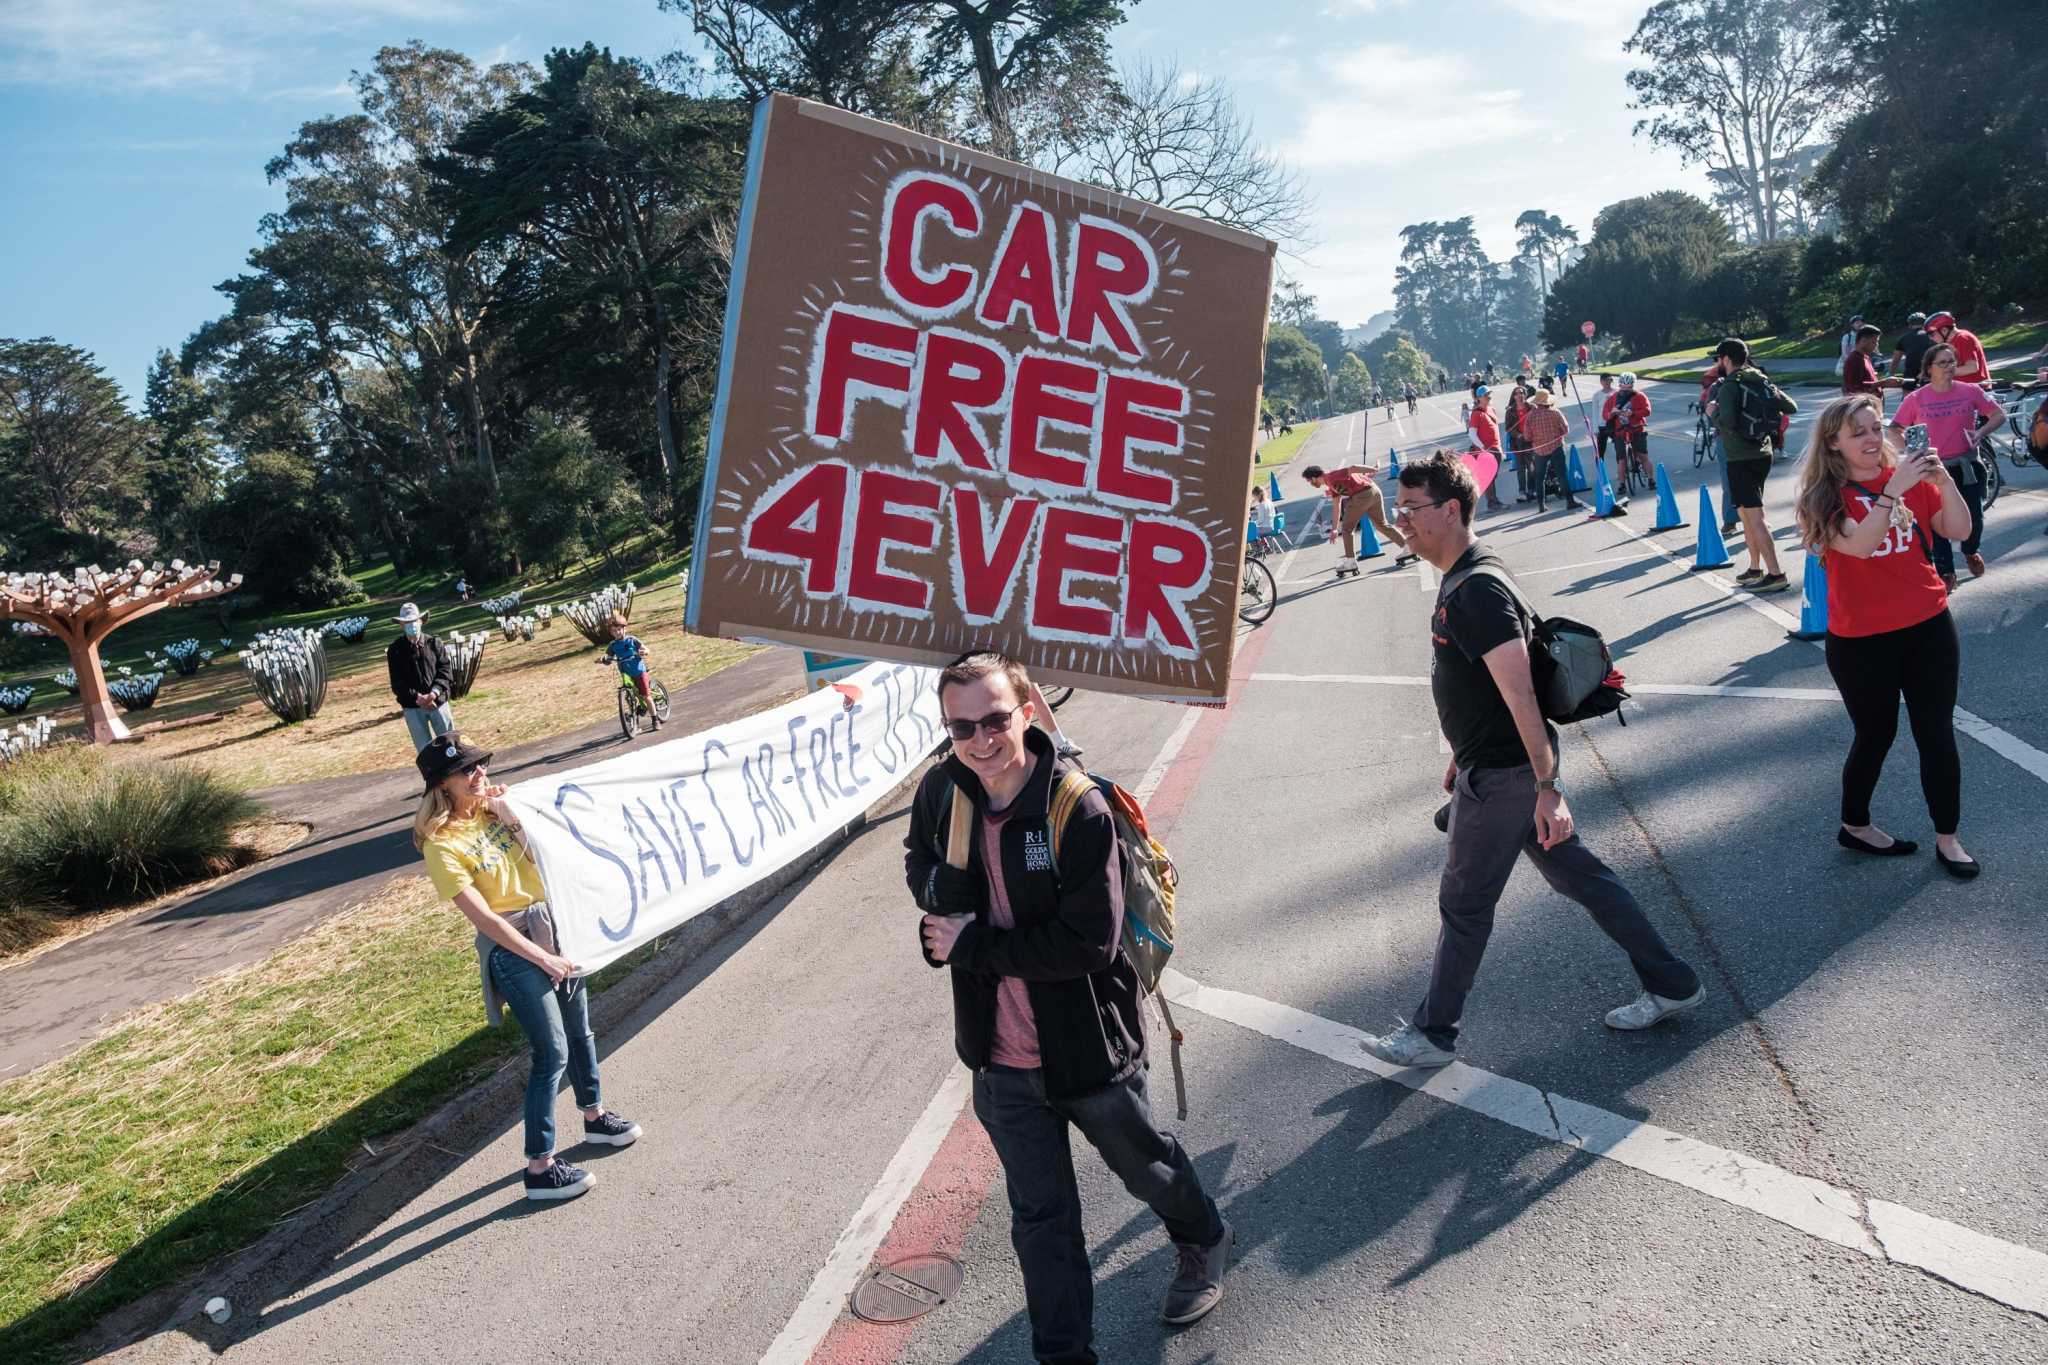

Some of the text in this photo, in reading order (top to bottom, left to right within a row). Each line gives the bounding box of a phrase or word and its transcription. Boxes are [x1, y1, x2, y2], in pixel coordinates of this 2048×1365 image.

[880, 171, 1159, 360] CAR
[806, 302, 1190, 511] FREE
[741, 459, 1213, 659] 4EVER
[555, 780, 721, 942] SAVE
[702, 704, 871, 867] CAR-FREE
[1025, 853, 1049, 861] COLLE
